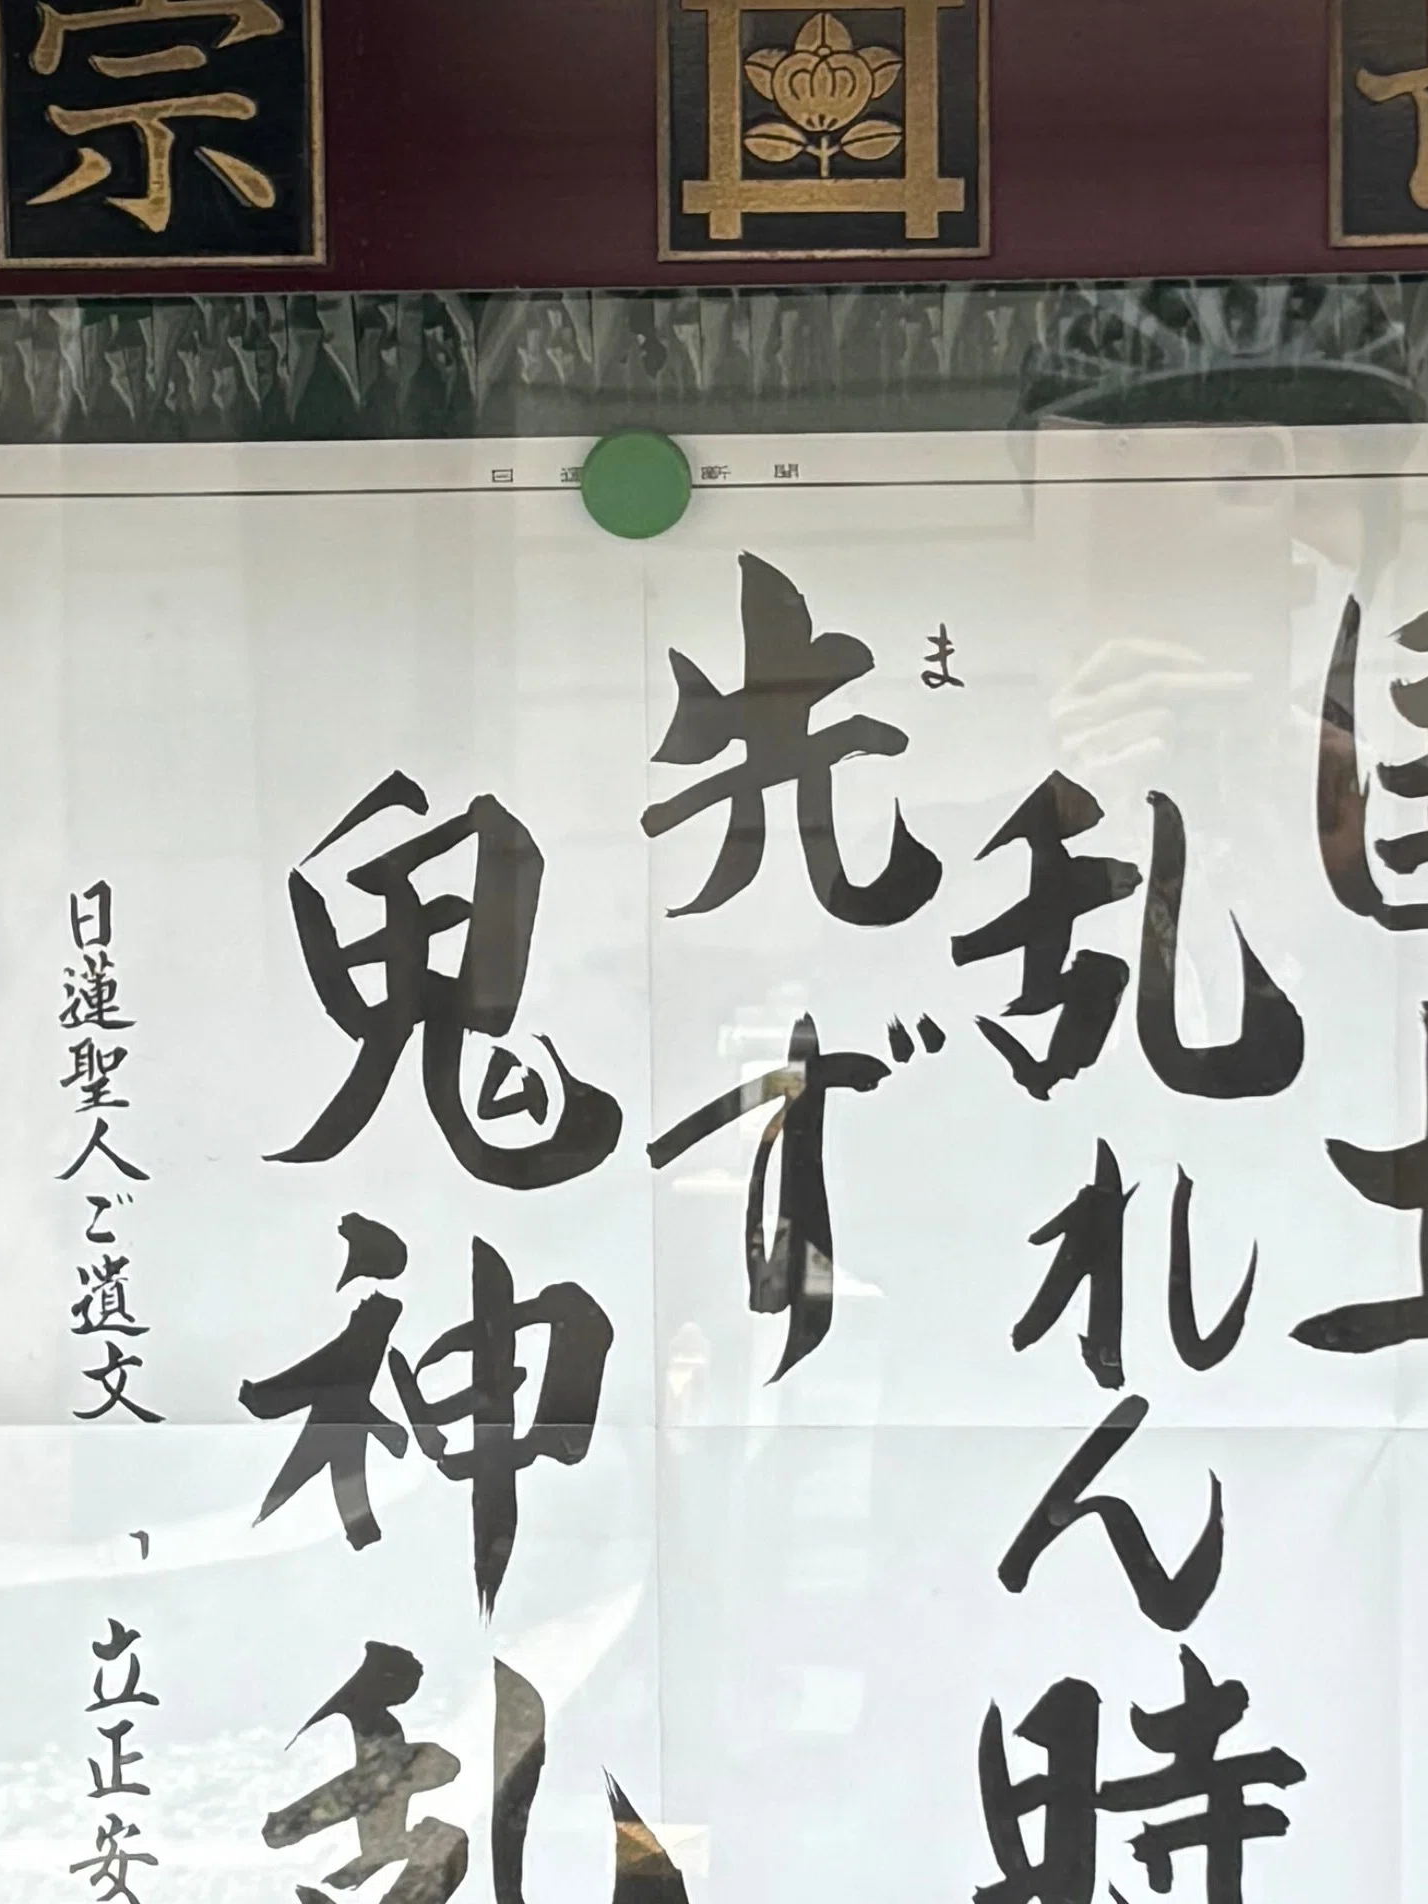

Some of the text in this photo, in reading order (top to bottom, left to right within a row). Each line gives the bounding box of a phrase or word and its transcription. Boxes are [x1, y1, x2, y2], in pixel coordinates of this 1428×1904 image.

[921, 622, 965, 689] ま
[54, 880, 167, 1424] 日蓮聖人ご遺文
[640, 549, 944, 1386] 先ず
